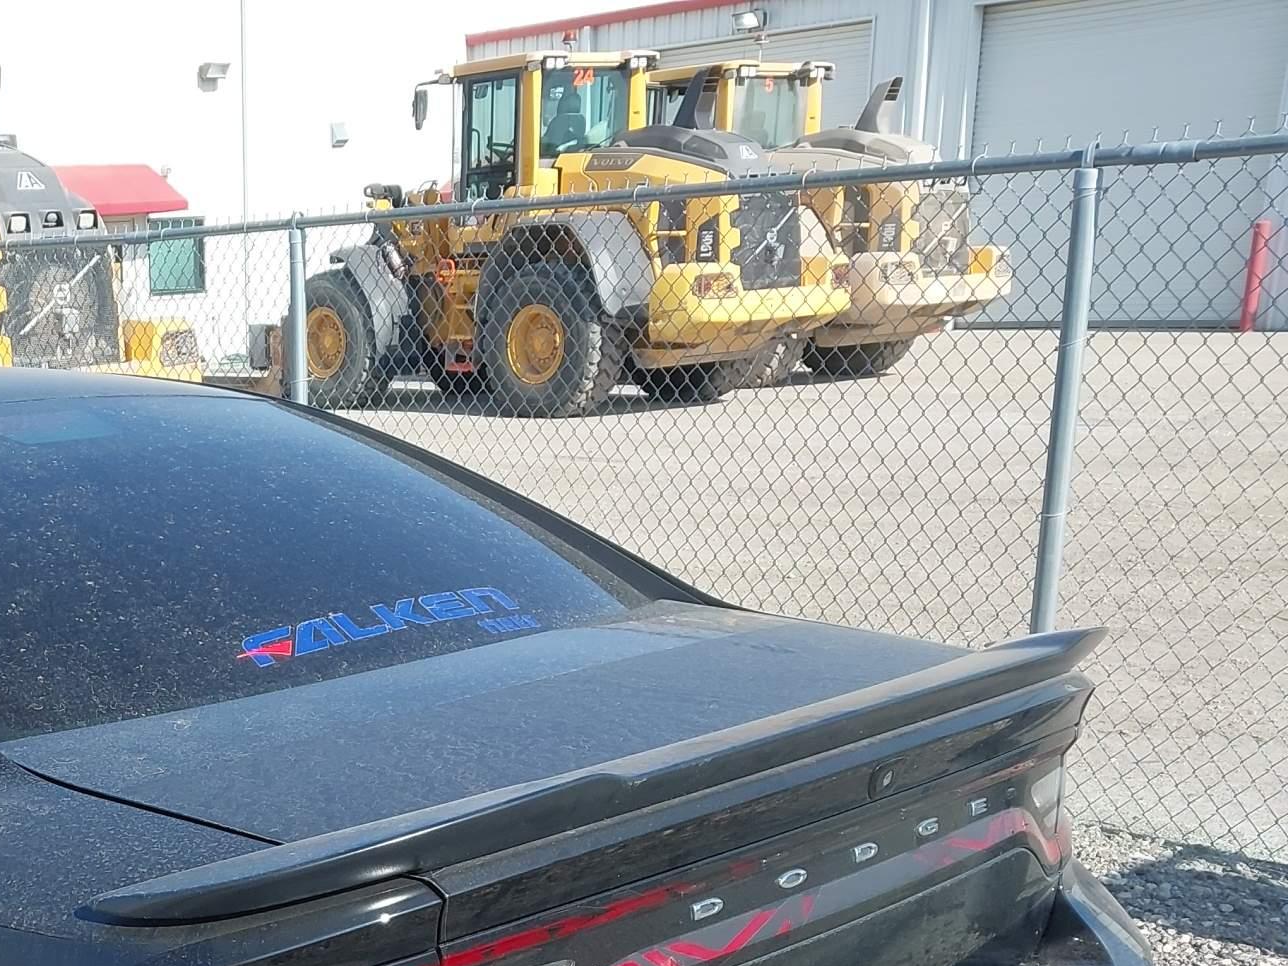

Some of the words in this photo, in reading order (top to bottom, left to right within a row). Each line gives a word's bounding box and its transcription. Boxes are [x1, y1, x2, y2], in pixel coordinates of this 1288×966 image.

[573, 66, 595, 87] 24
[765, 78, 774, 94] 5
[591, 157, 634, 167] VOLVO
[236, 586, 520, 668] FALKEN
[689, 796, 990, 922] DODGE
